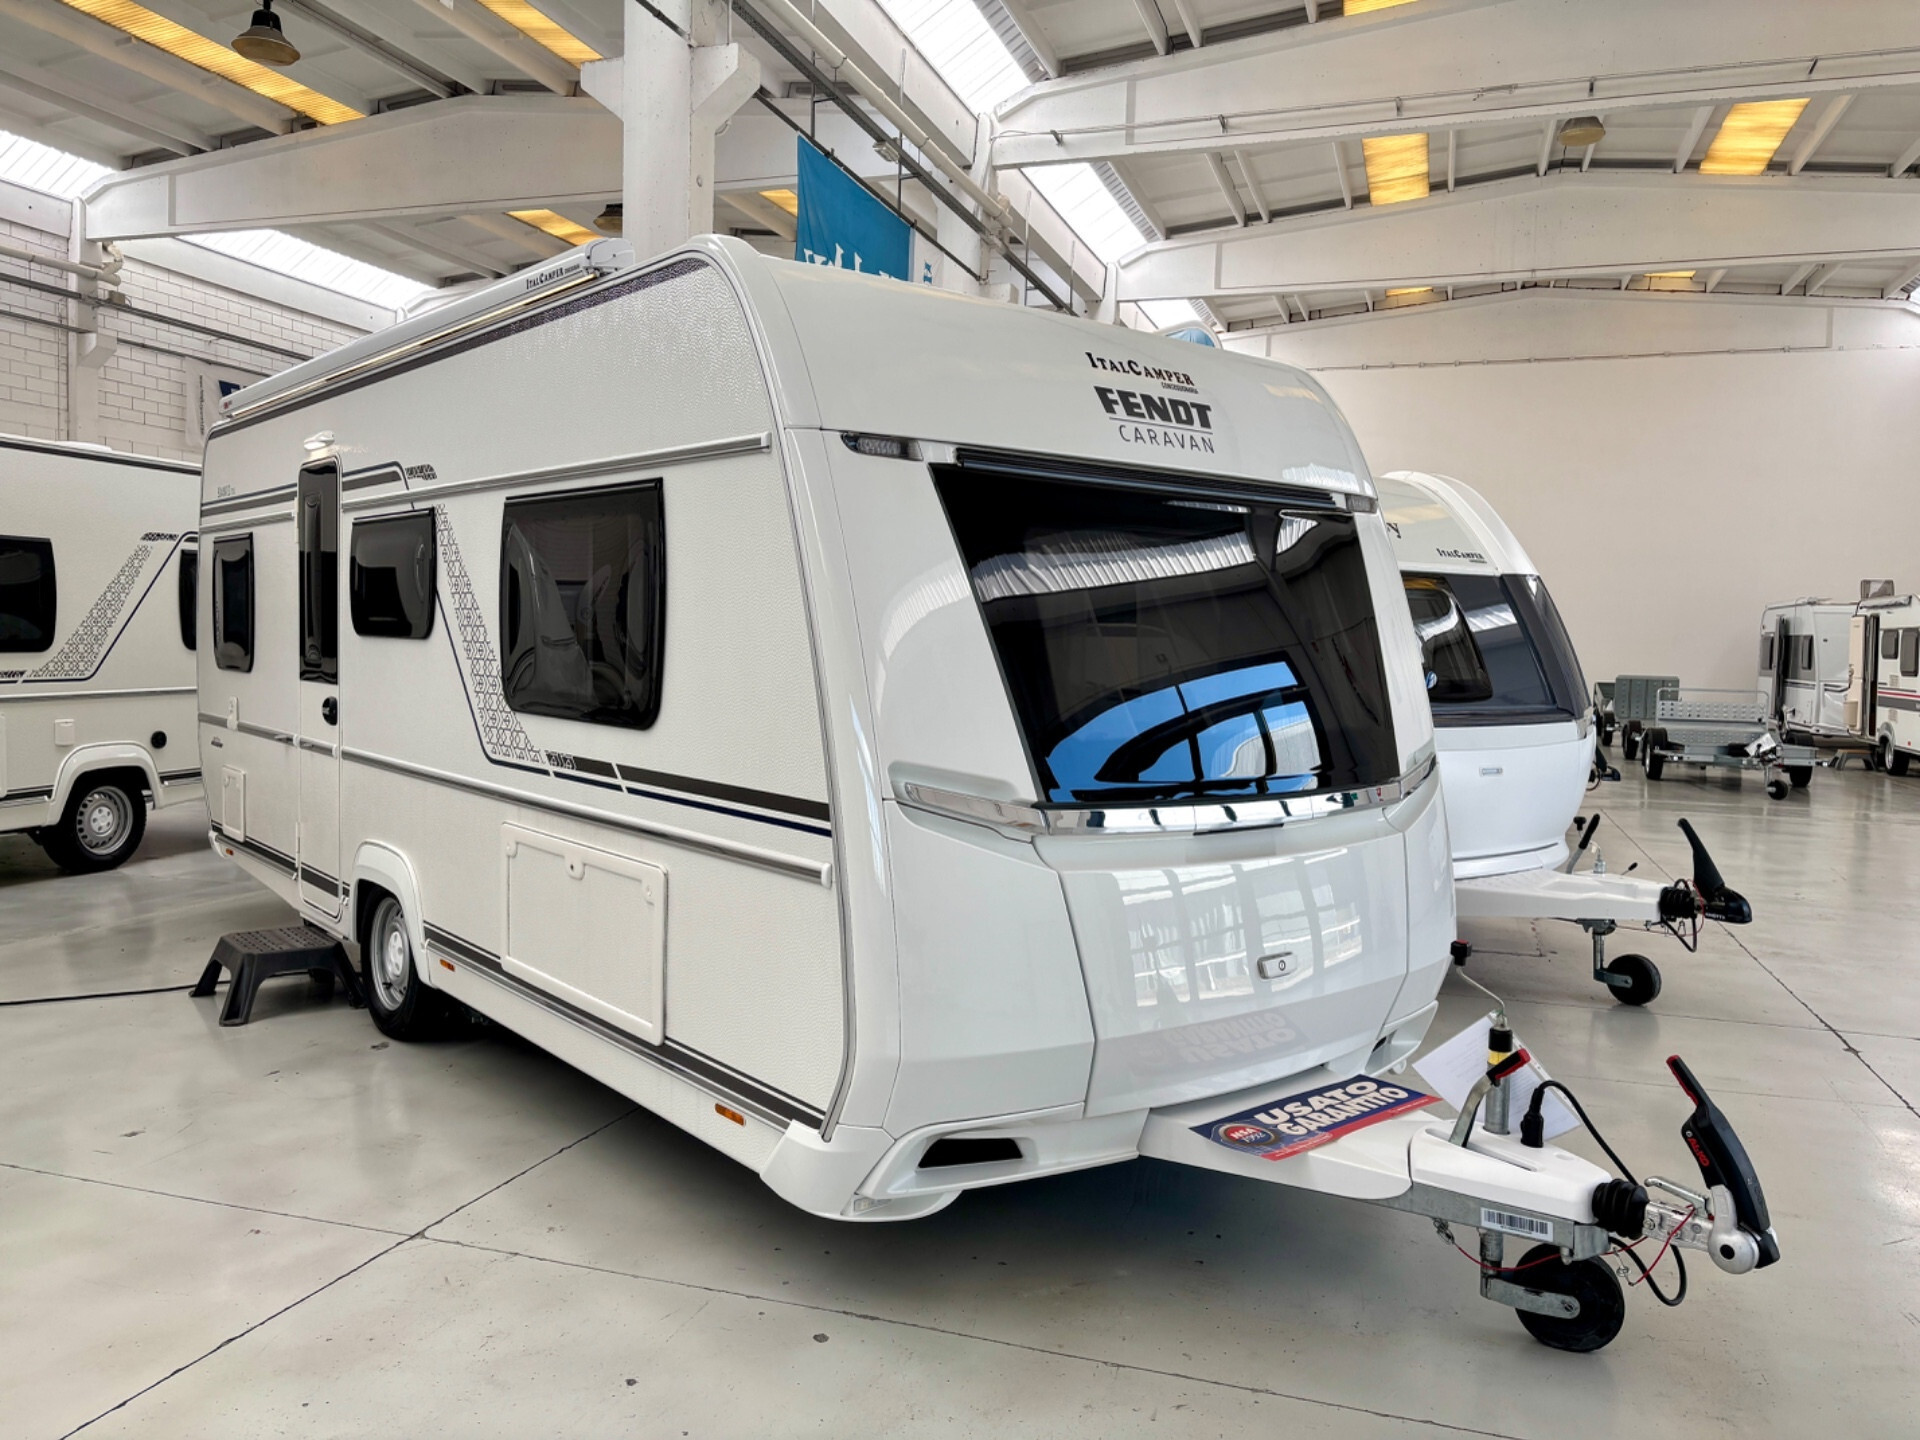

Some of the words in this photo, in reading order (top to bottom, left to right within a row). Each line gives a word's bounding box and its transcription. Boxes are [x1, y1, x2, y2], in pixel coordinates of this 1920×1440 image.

[1094, 386, 1212, 429] FENDT
[1119, 425, 1215, 453] CARAVAN
[1254, 1081, 1378, 1125] USATO
[1276, 1087, 1409, 1136] GARANTITO
